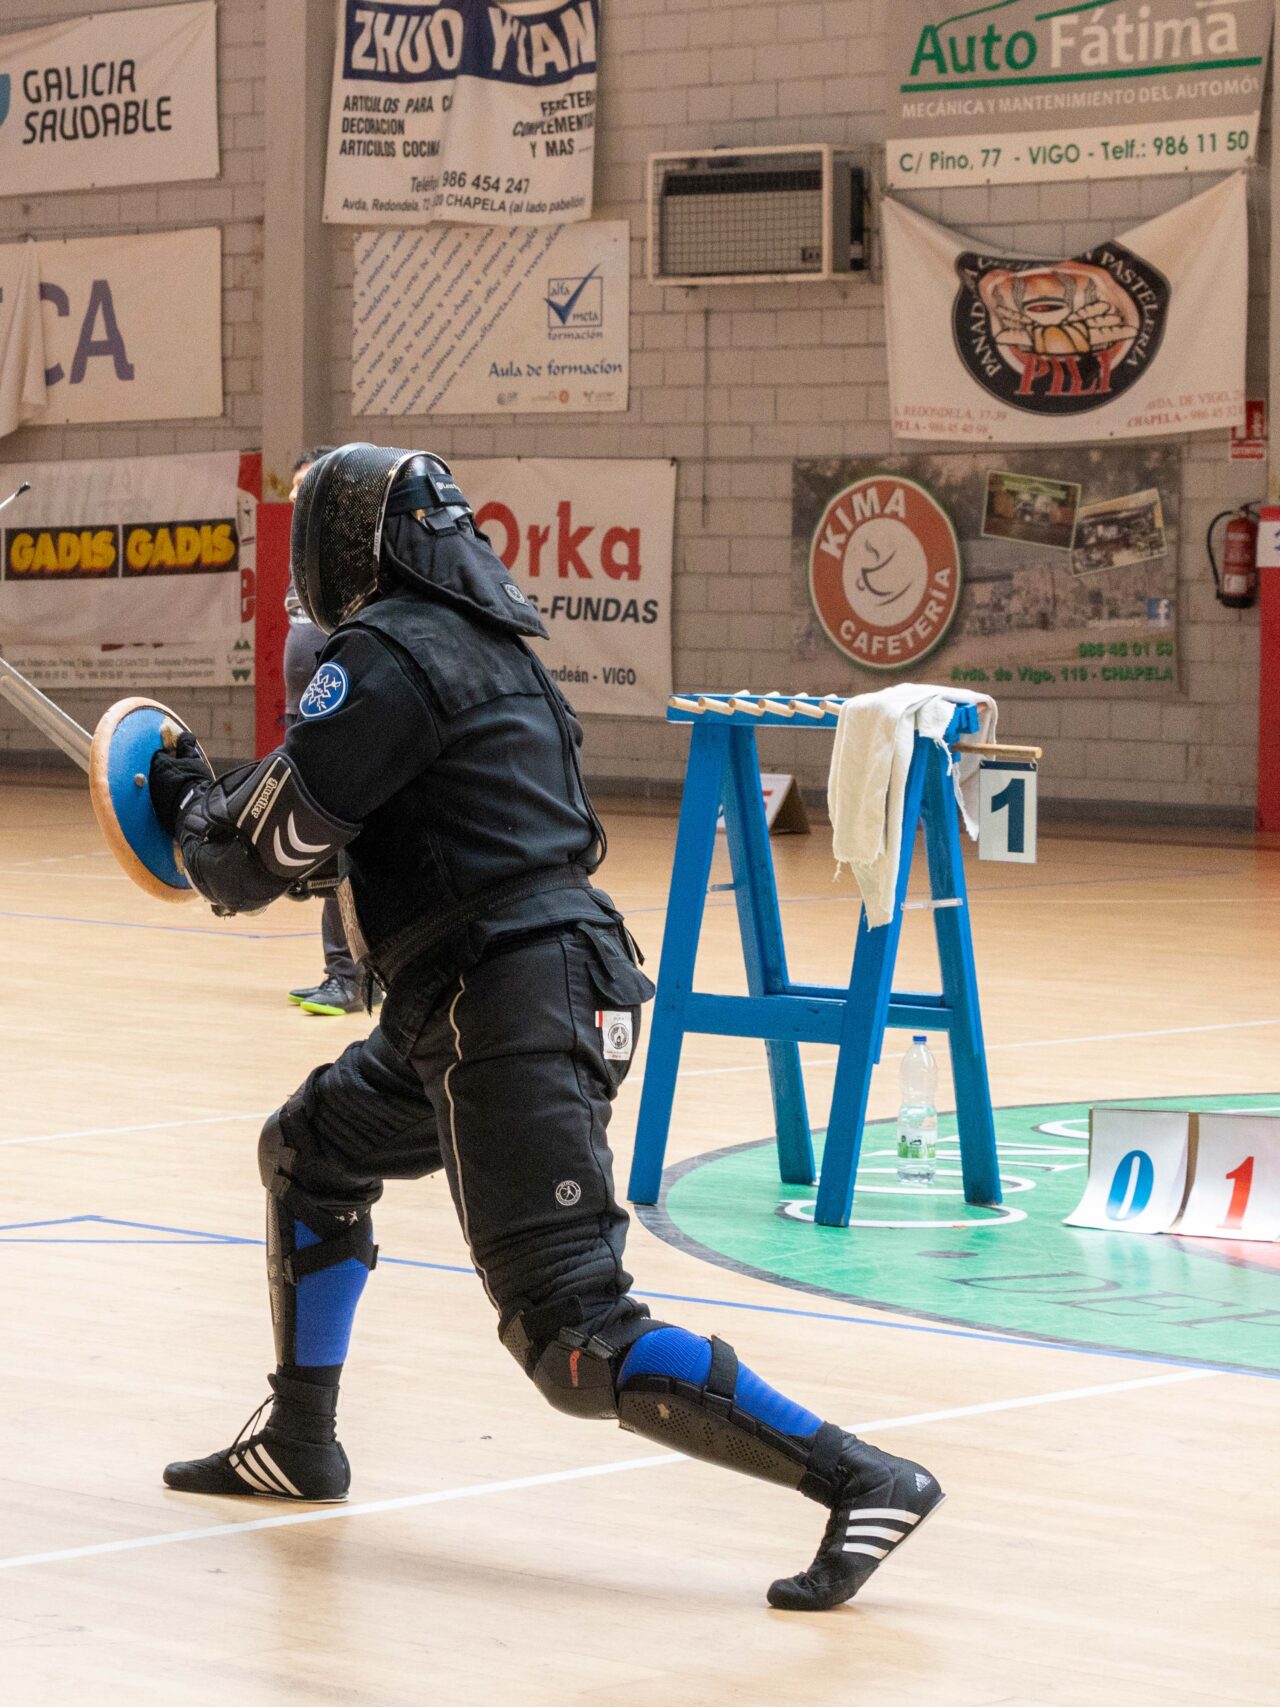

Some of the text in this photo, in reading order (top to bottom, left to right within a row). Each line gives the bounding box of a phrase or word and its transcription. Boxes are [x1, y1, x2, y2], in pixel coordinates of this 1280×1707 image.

[351, 7, 464, 74] ZHUO
[909, 5, 1238, 75] Auto Fátima
[23, 58, 135, 104] GALICIA
[342, 95, 434, 114] ARTICULOS PARA
[902, 98, 984, 119] MECÁNICA
[985, 101, 997, 115] Y
[997, 88, 1136, 114] MANTENIMIENTO
[1139, 84, 1172, 103] DEL
[22, 96, 173, 146] SAUDABLE
[341, 117, 406, 136] DECORACION
[340, 138, 396, 157] ARTICULOS
[529, 138, 575, 159] Y MAS
[929, 150, 974, 172] Pino,
[980, 148, 1002, 167] 77
[1028, 144, 1081, 166] VIGO
[1152, 137, 1188, 157] 986
[1196, 133, 1217, 153] 11
[1226, 130, 1249, 150] 50
[442, 171, 530, 194] 986 454 247
[445, 193, 506, 213] CHAPELA
[488, 357, 623, 378] Aula de formación
[819, 487, 907, 561] KIMA
[9, 530, 117, 573] GADIS
[126, 523, 237, 567] GADIS
[602, 668, 637, 686] VIGO
[1100, 667, 1172, 682] CHAPELA
[991, 777, 1026, 854] 1
[1106, 1149, 1155, 1222] 0
[1216, 1155, 1255, 1231] 1
